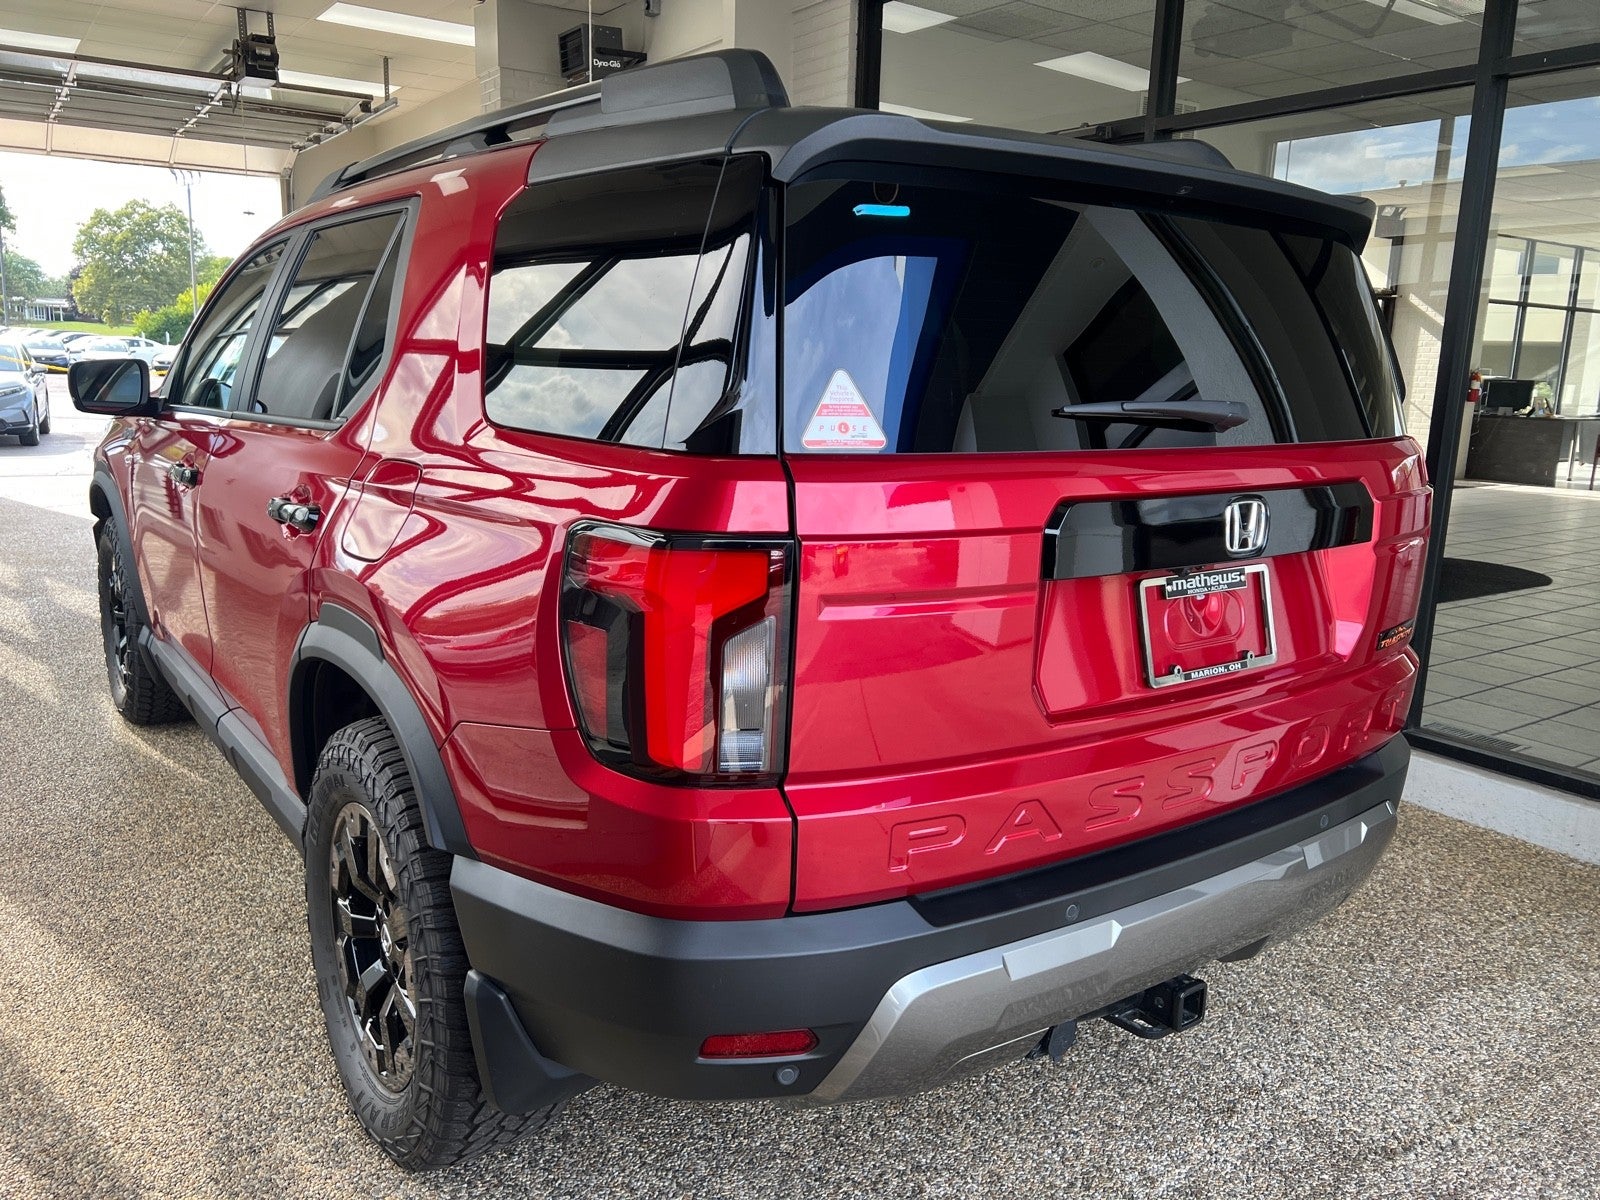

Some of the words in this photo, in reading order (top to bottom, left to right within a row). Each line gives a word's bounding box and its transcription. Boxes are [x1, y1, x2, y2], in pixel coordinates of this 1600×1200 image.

[1172, 571, 1241, 591] mathews
[1228, 663, 1242, 671] OH
[888, 690, 1405, 873] PASSPORT
